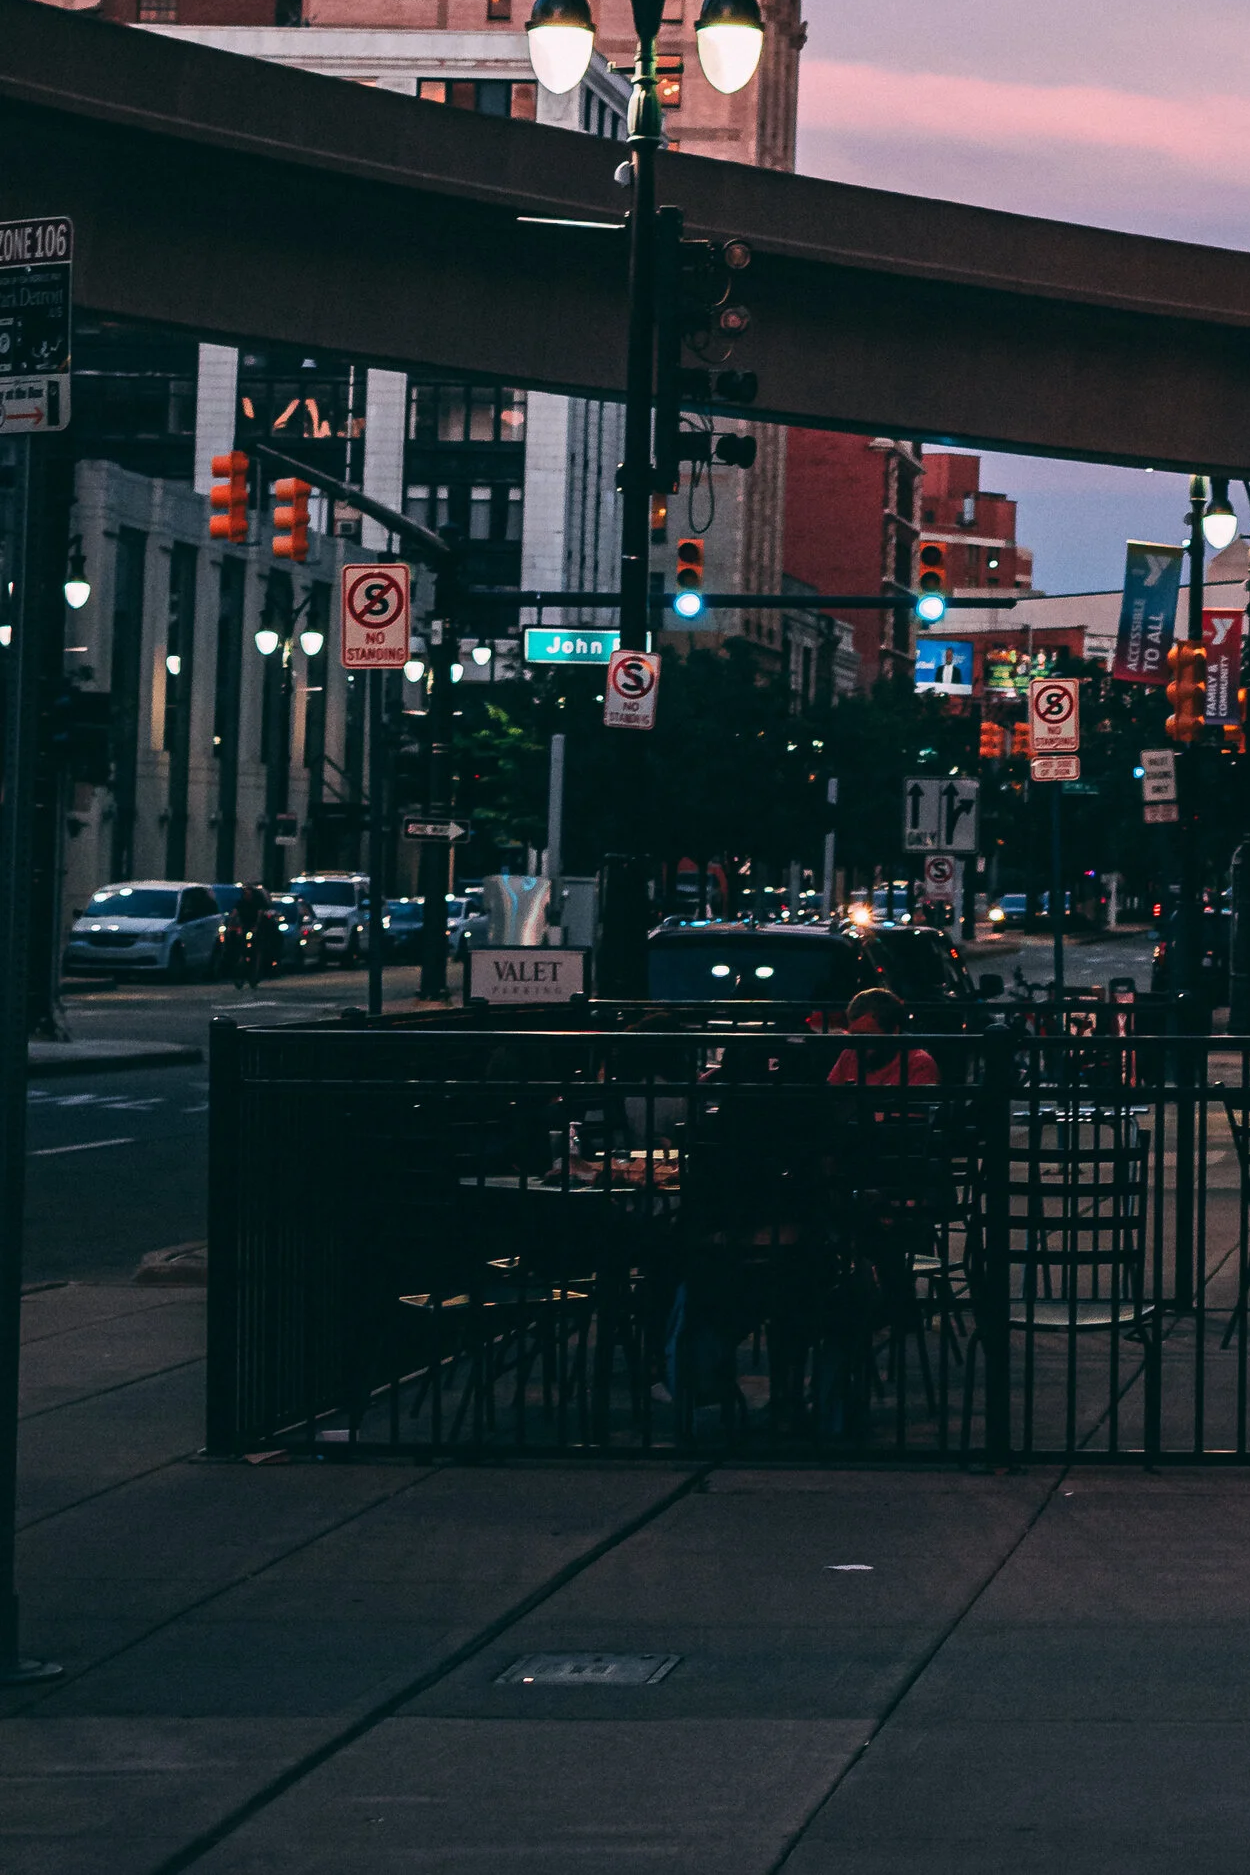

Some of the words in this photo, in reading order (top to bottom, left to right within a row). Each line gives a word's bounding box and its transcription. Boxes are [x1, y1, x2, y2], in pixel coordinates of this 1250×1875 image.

[34, 223, 68, 258] 106
[19, 285, 63, 307] Detroit
[364, 631, 386, 645] NO
[1126, 598, 1147, 672] ACCESSIBLE
[1148, 611, 1165, 644] ALL
[346, 647, 405, 662] STANDING
[545, 635, 603, 655] John
[1144, 647, 1161, 672] TO
[1205, 673, 1218, 717] FAMILY
[1218, 655, 1229, 718] COMMUNITY
[622, 702, 640, 712] NO
[1047, 725, 1062, 735] NO
[907, 831, 937, 846] ONLY
[493, 960, 563, 982] VALET
